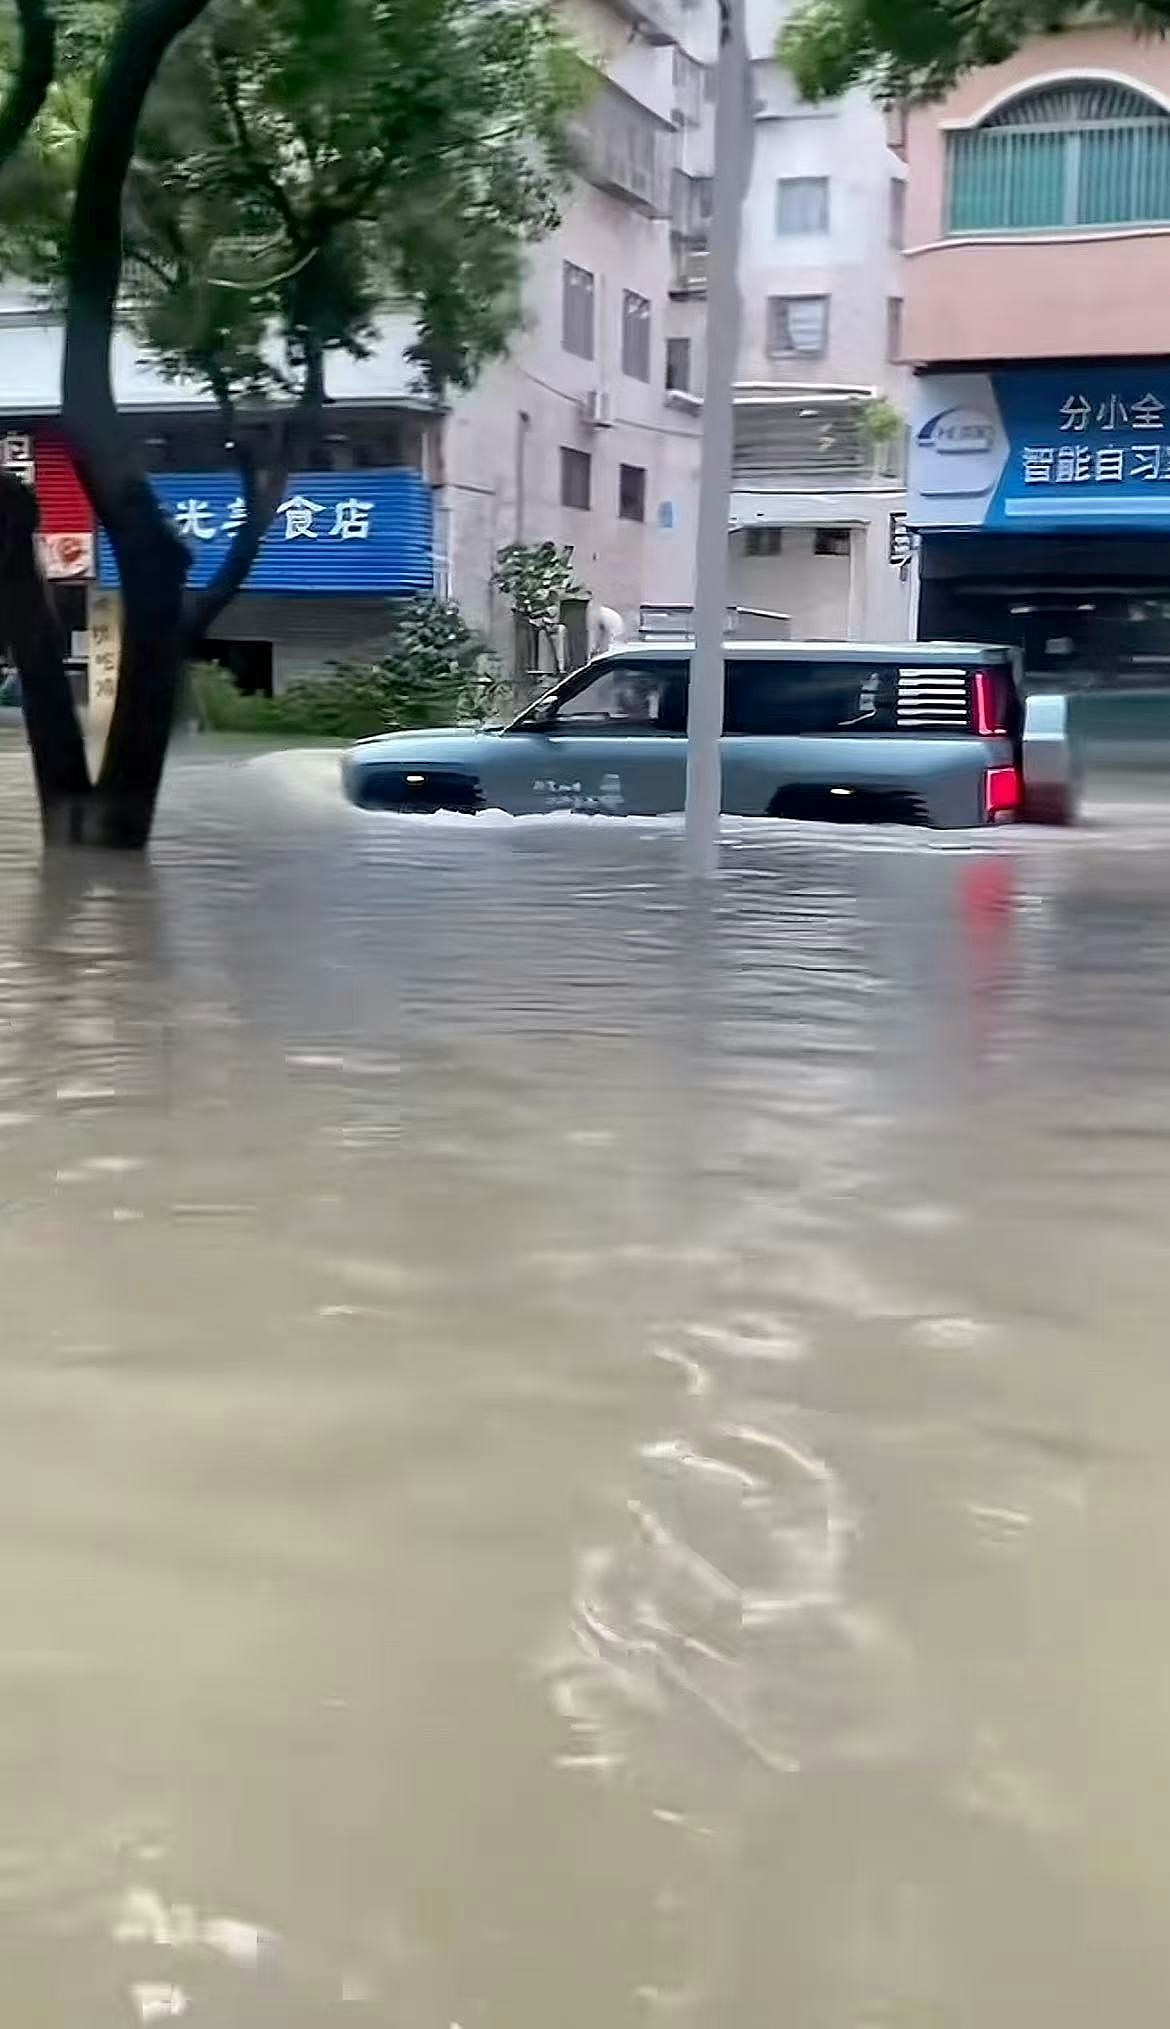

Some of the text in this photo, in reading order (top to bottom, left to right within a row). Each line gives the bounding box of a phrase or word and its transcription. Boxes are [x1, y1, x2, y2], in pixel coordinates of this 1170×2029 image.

[1059, 393, 1166, 431] 分小全
[1022, 445, 1170, 482] 智能自习
